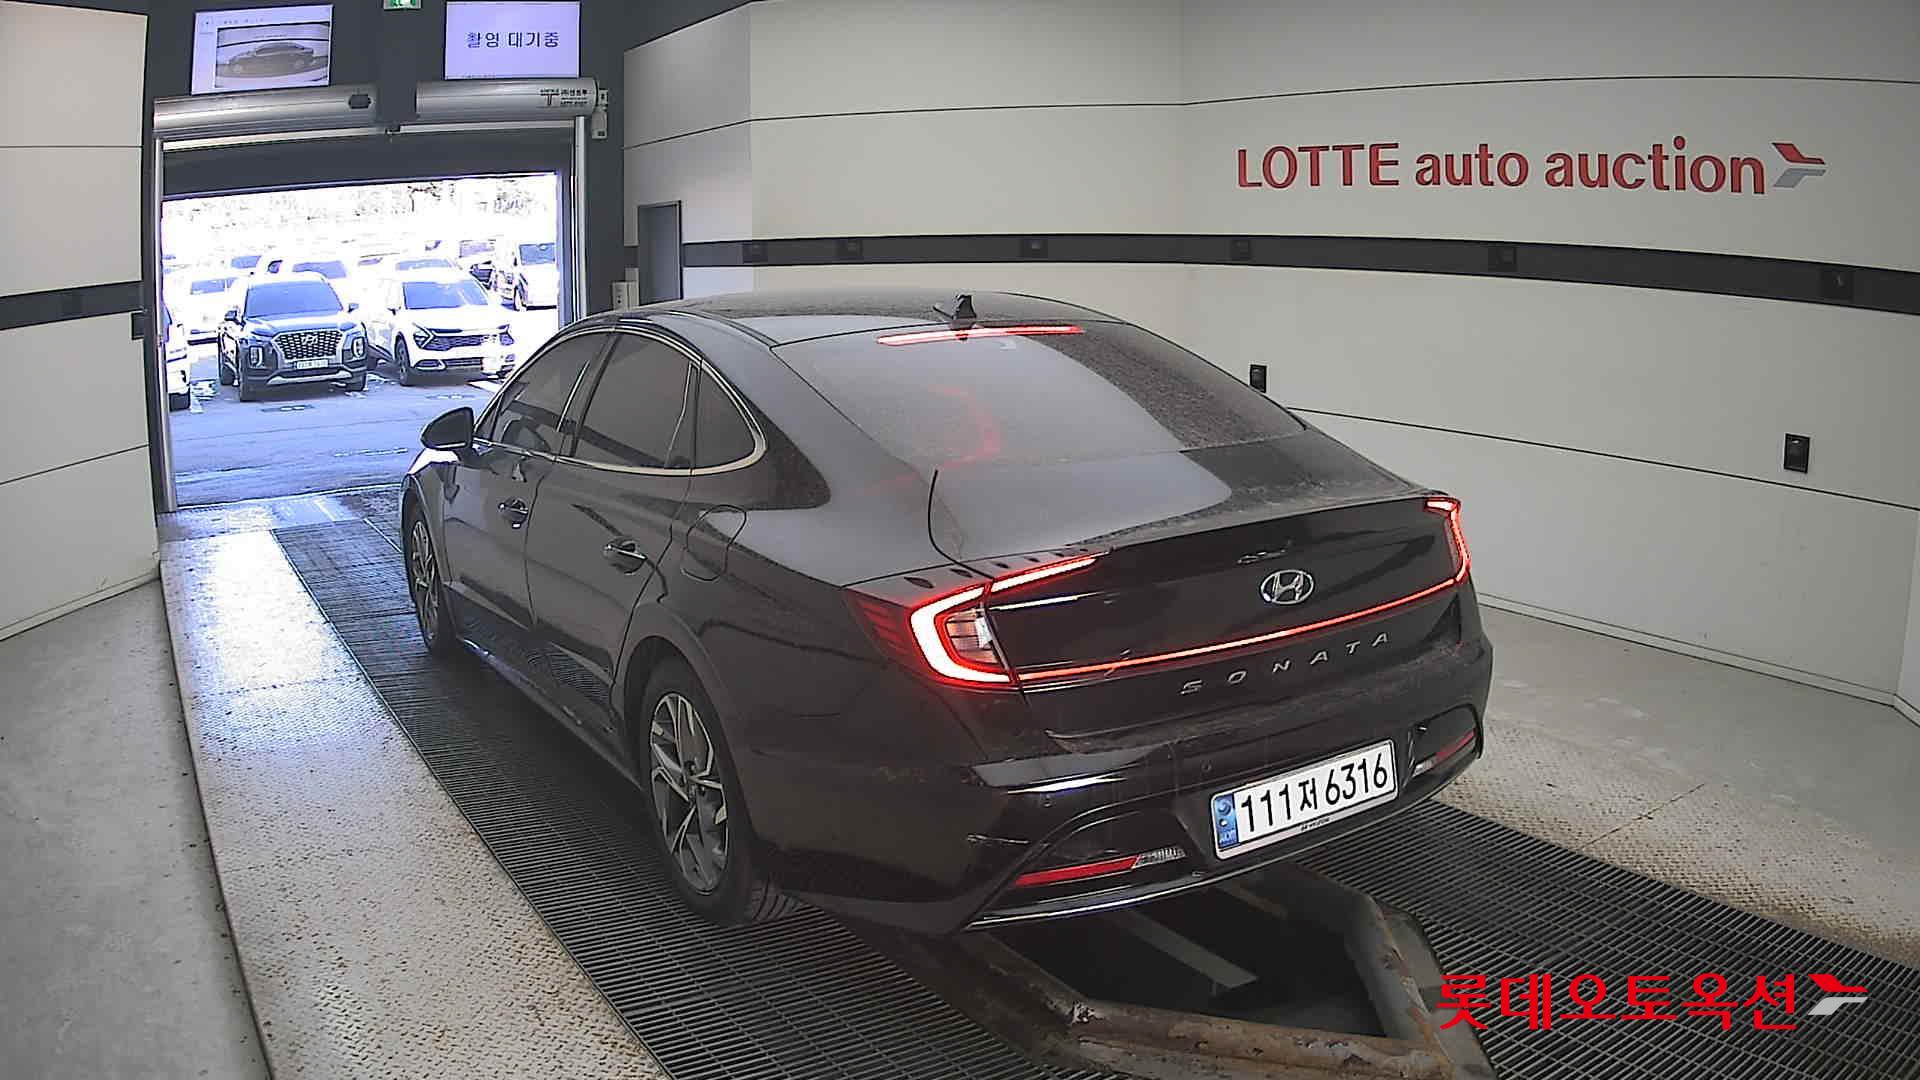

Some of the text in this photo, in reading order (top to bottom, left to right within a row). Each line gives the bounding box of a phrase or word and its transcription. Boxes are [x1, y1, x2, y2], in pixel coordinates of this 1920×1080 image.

[467, 31, 560, 49] 촬영 대기중
[1238, 135, 1766, 195] LOTTE auto auction
[1179, 632, 1389, 695] SONATA
